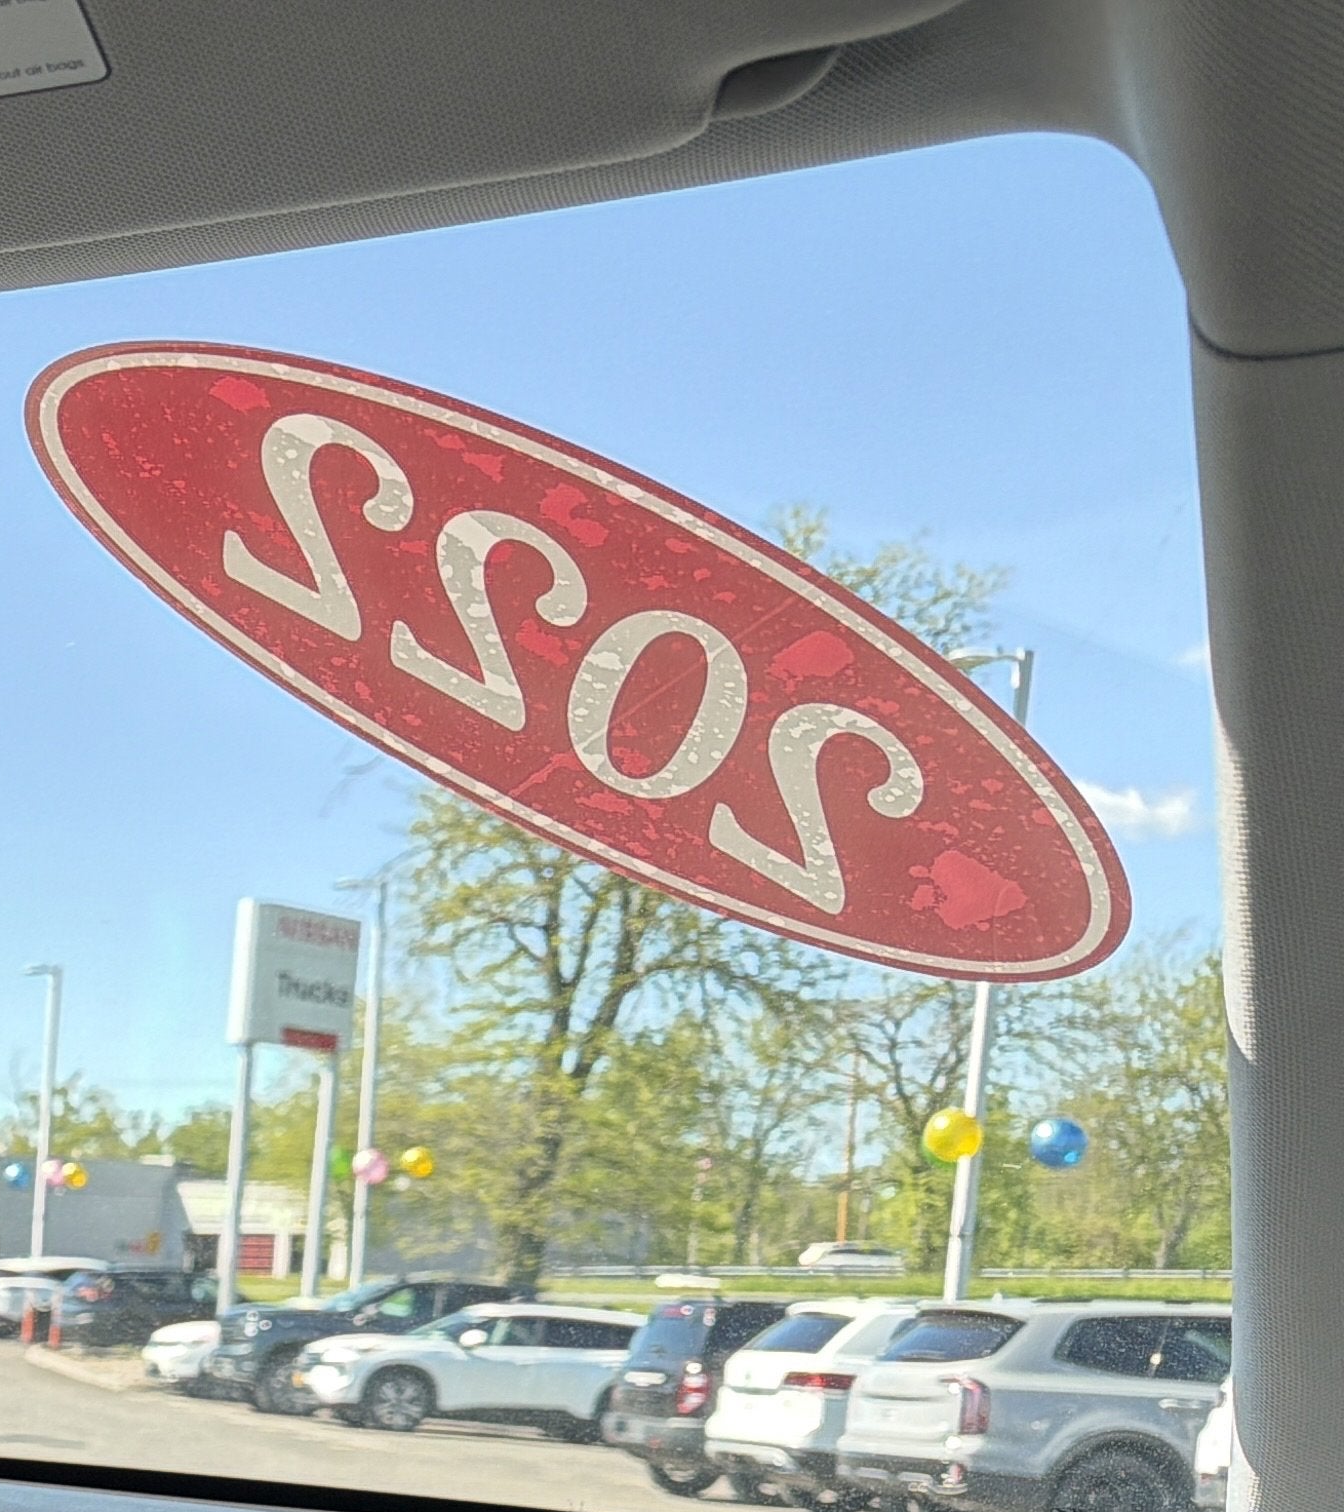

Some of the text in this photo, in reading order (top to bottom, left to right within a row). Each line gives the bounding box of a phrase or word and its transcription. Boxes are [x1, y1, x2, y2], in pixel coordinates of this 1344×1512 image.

[24, 63, 44, 77] air
[45, 57, 86, 75] bags
[277, 969, 351, 1008] Trucks
